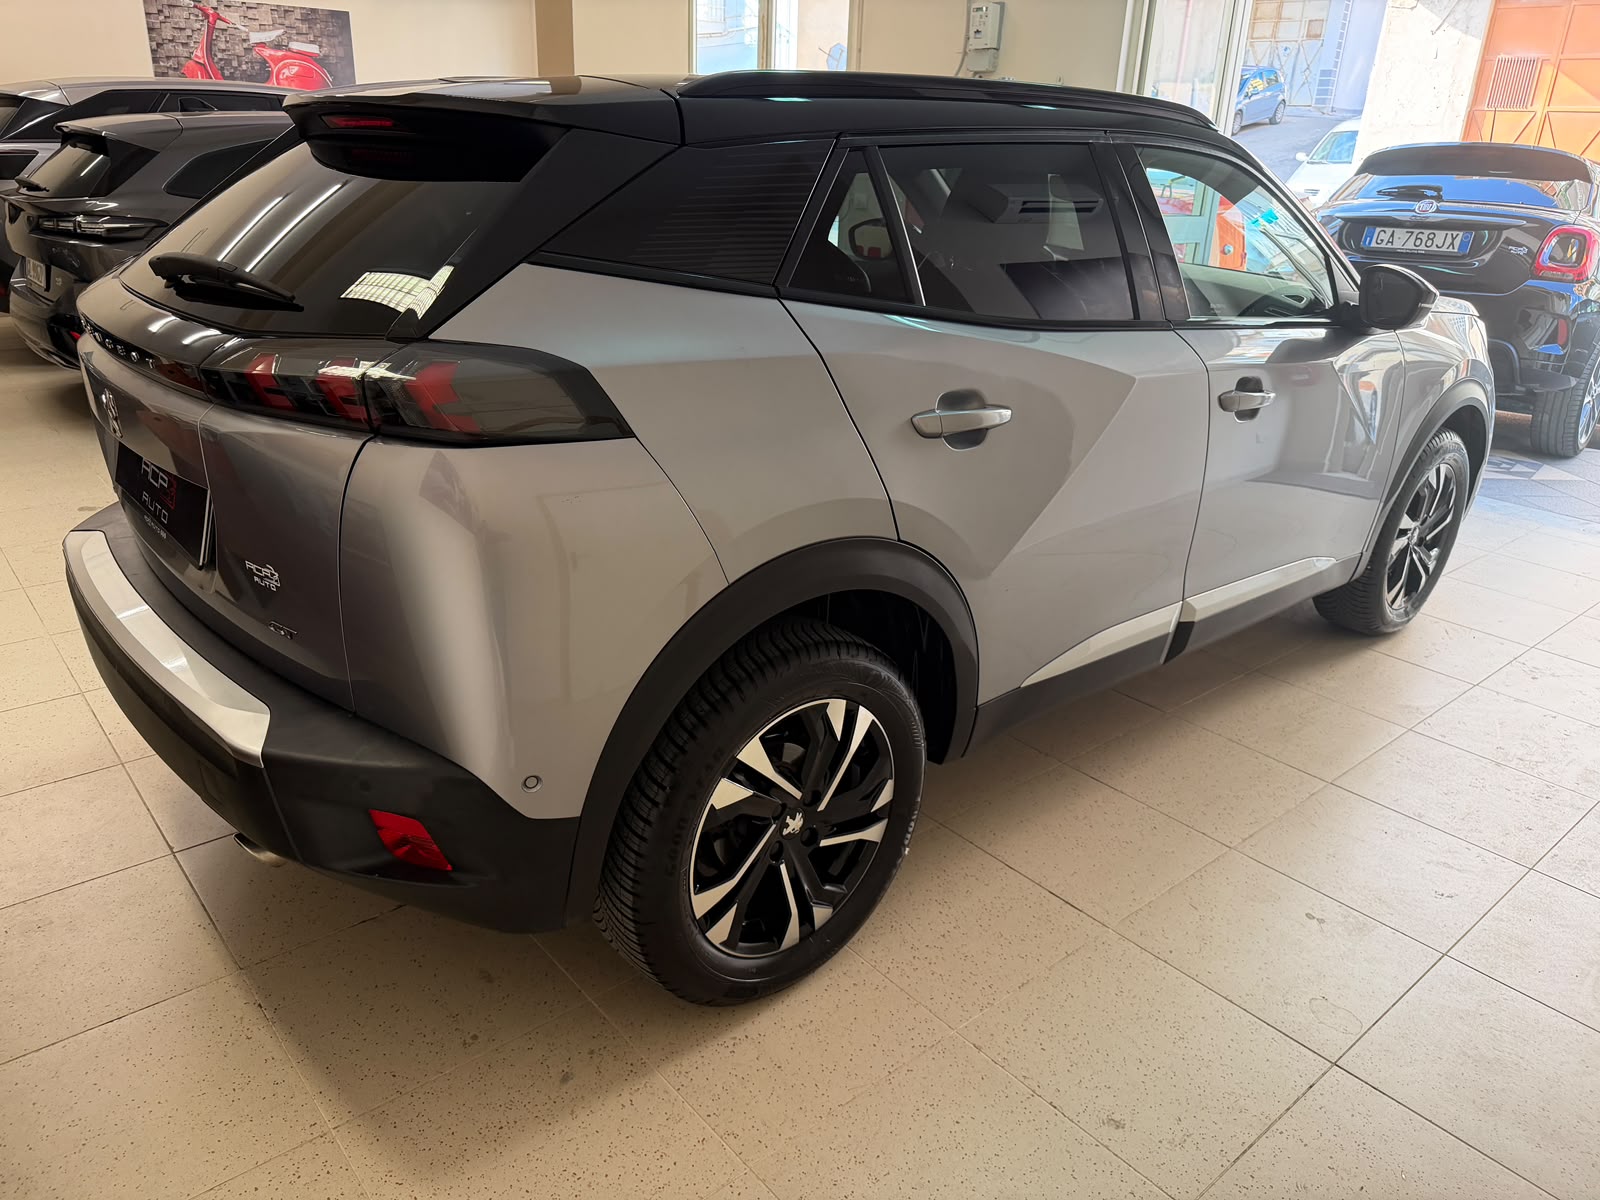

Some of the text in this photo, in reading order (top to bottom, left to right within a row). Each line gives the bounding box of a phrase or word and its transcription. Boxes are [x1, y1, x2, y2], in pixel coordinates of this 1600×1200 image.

[1375, 229, 1460, 250] GA 768JX
[142, 491, 168, 524] AUTO
[253, 575, 277, 591] AUTO
